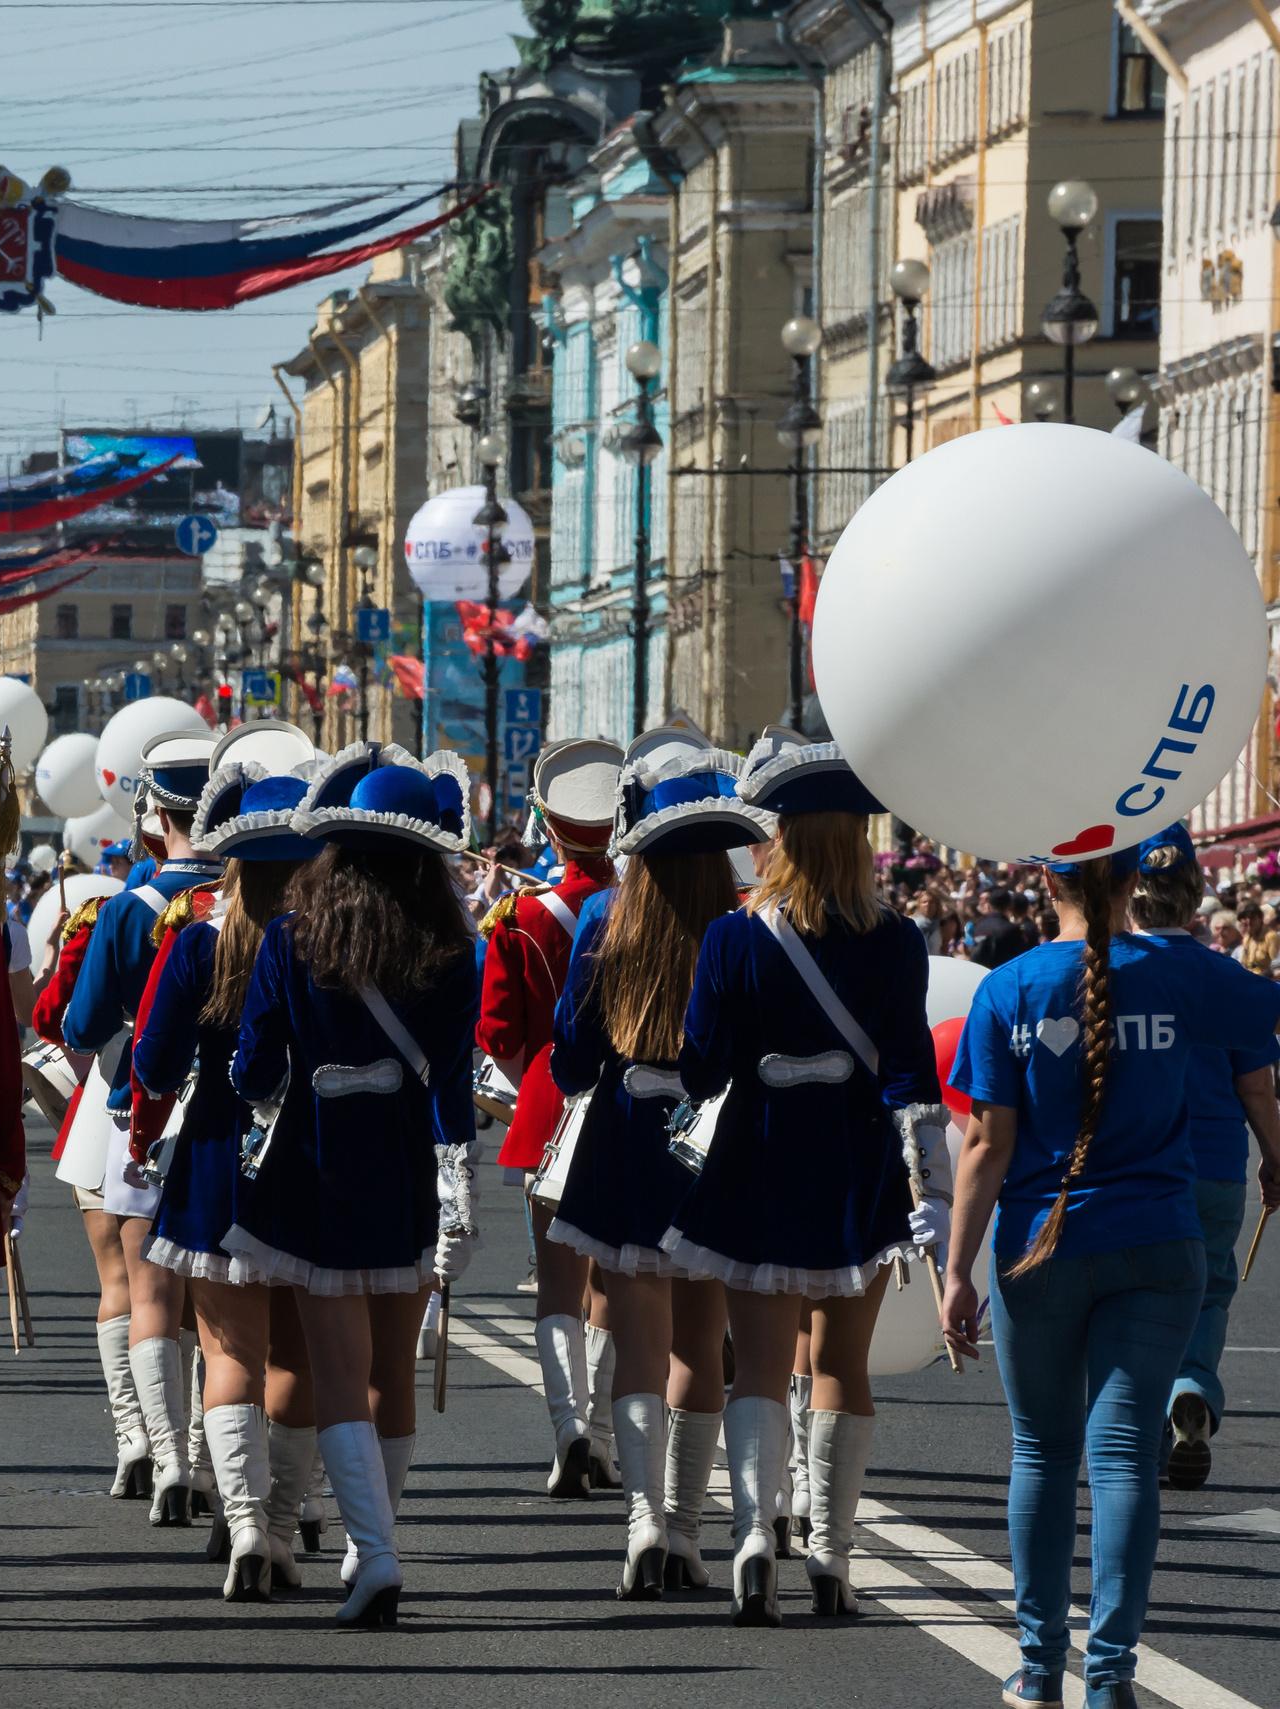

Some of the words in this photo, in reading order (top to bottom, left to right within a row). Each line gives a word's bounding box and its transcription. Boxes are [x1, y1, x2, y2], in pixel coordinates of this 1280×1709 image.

[415, 541, 451, 558] СПБ
[1115, 684, 1216, 817] СПБ
[1107, 1014, 1176, 1051] ПБ
